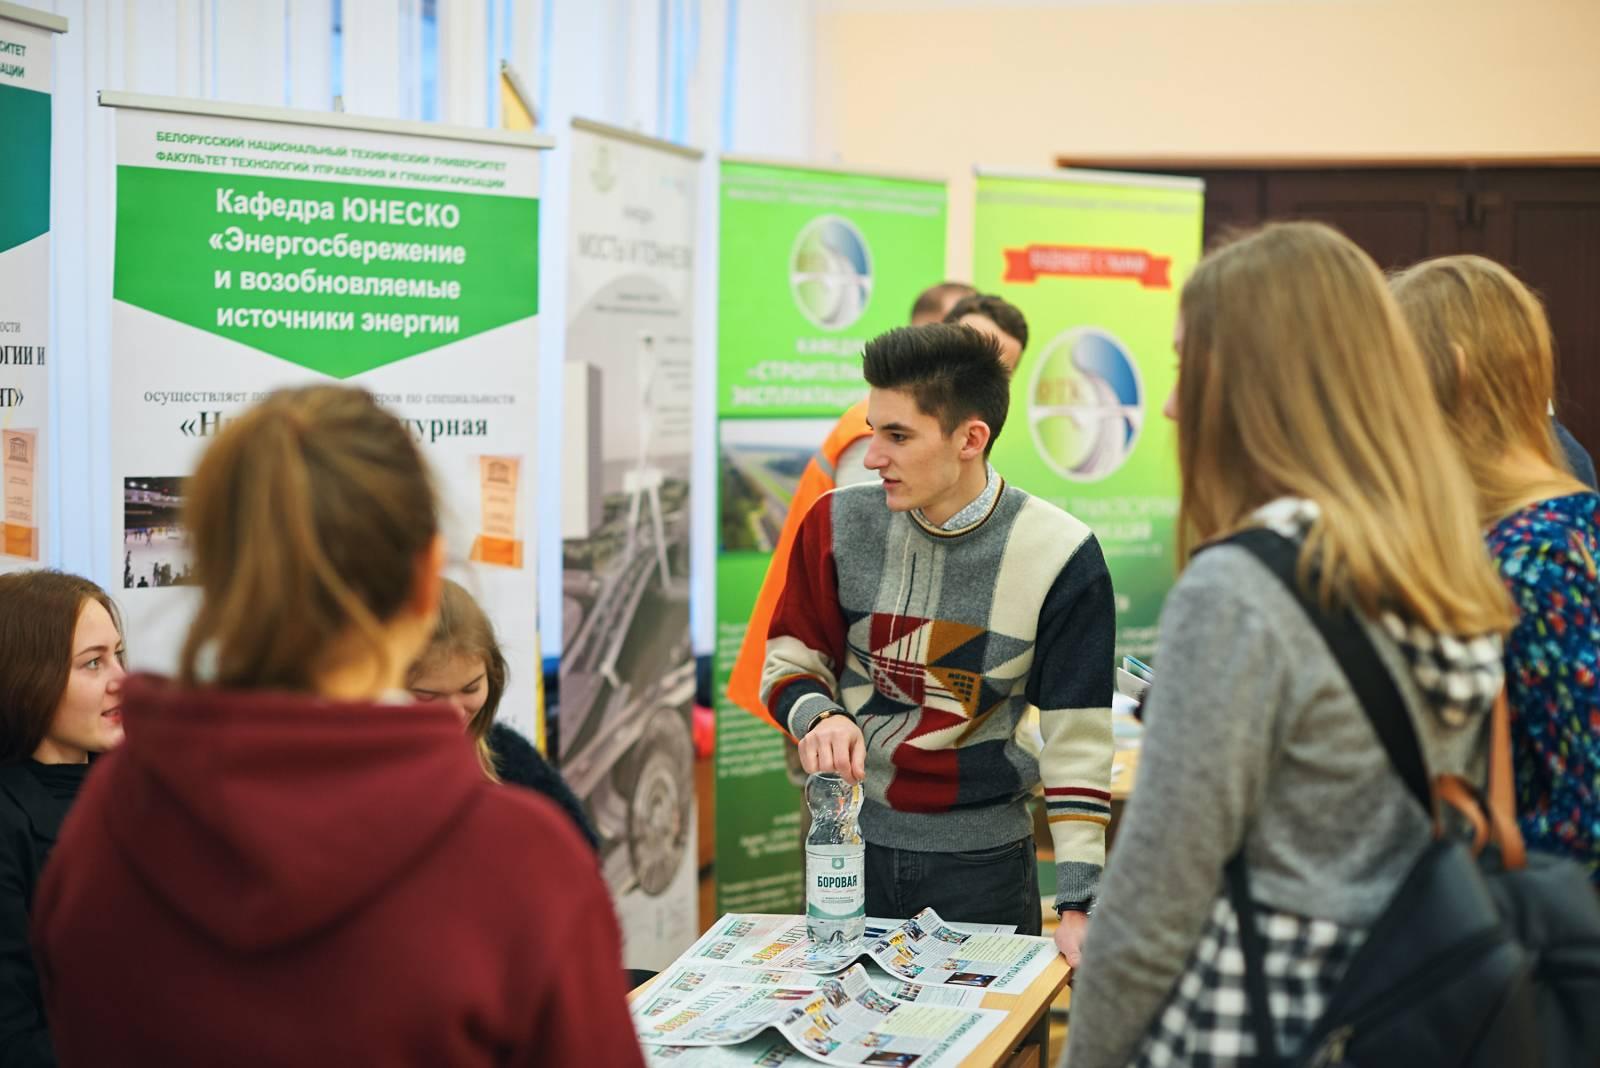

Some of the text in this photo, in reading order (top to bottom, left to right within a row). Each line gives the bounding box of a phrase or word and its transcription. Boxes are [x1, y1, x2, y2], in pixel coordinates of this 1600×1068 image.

[156, 131, 245, 148] БЕЛОРУССКИЙ
[248, 140, 347, 157] НАЦИОНАЛЬНЫЙ
[156, 151, 227, 166] ФАКУЛЬТЕТ
[231, 156, 309, 173] ТЕХНОЛОГИЙ
[216, 188, 460, 229] Кафедра ЮНЕСКО
[208, 226, 467, 265] «Энергосбережение
[214, 268, 461, 300] и возобновляемые
[216, 307, 459, 338] источники энергии
[144, 391, 248, 406] осуществляет
[817, 874, 858, 889] БОРОВАЯ
